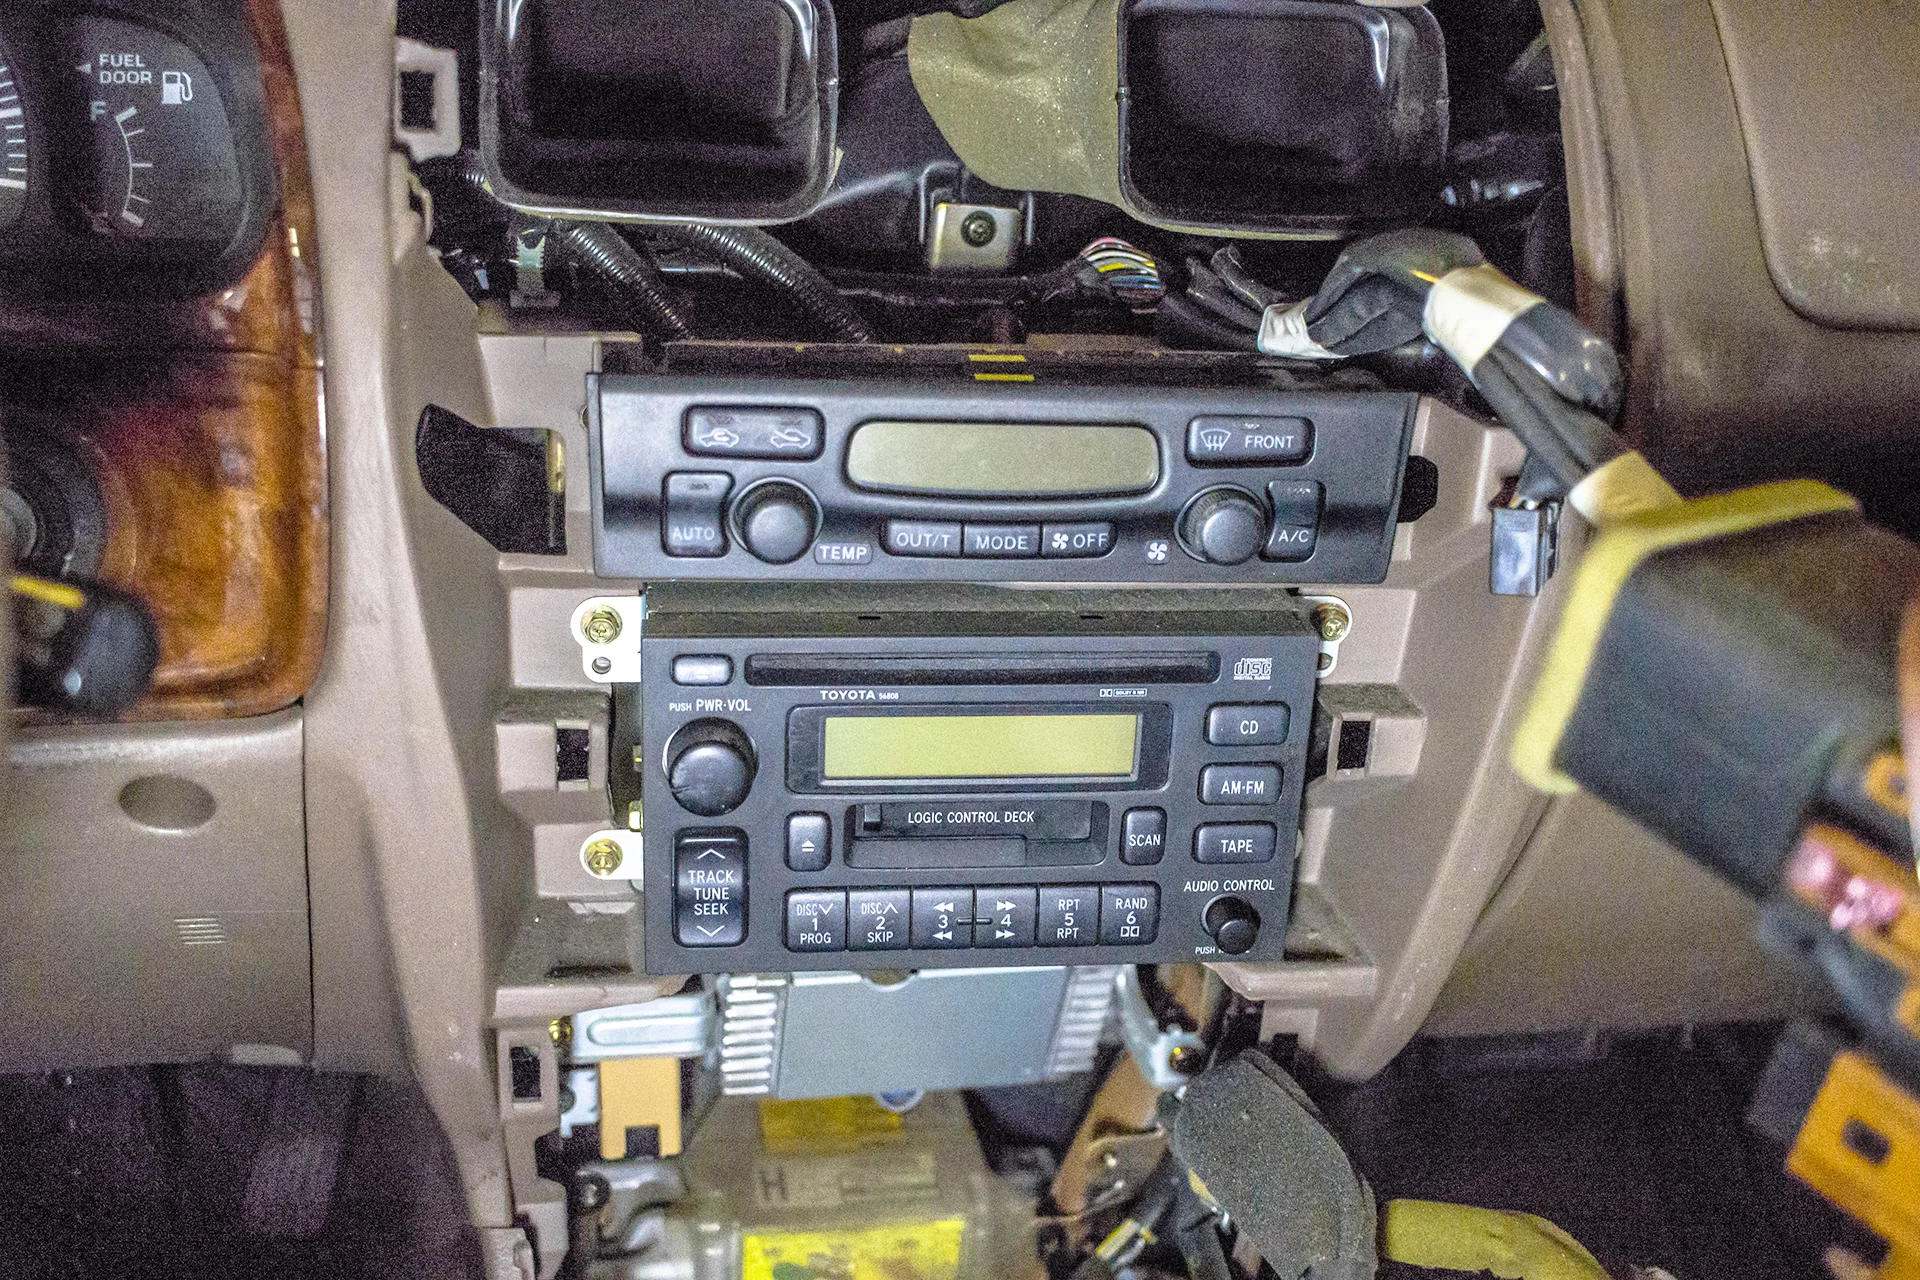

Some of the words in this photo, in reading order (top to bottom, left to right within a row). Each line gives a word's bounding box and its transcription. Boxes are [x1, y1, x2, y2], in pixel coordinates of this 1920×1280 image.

[99, 53, 145, 68] FUEL
[99, 71, 152, 84] DOOR
[91, 101, 106, 120] F
[1244, 435, 1295, 450] FRONT
[672, 526, 715, 541] AUTO
[896, 532, 951, 549] OUT/T
[1278, 529, 1309, 544] A/C
[976, 535, 1028, 550] MODE
[1073, 533, 1109, 549] OFF
[819, 544, 867, 561] TEMP
[820, 690, 876, 700] TOYOTA
[669, 702, 692, 712] PUSH
[1239, 720, 1259, 735] CD
[907, 811, 943, 824] LOGIC
[946, 811, 1001, 824] CONTROL
[1004, 811, 1035, 823] DECK
[1128, 834, 1161, 847] SCAN
[1221, 839, 1254, 853] TAPE
[688, 870, 734, 884] TRACK
[1183, 880, 1219, 893] AUDIO
[1223, 878, 1276, 892] CONTROL
[694, 887, 730, 901] TUNE
[694, 904, 728, 916] SEEK
[796, 903, 818, 917] DISC
[861, 902, 883, 916] DISC
[1058, 898, 1081, 912] RPT
[1115, 898, 1148, 910] RAND
[811, 918, 819, 932] 1
[875, 916, 886, 930] 2
[937, 914, 949, 930] 3
[1000, 913, 1012, 928] 4
[1064, 912, 1075, 927] 5
[1125, 911, 1137, 926] 6
[800, 932, 832, 946] PROG
[867, 931, 895, 944] SKIP
[1056, 926, 1080, 940] RPT
[1194, 945, 1216, 955] PUSH
